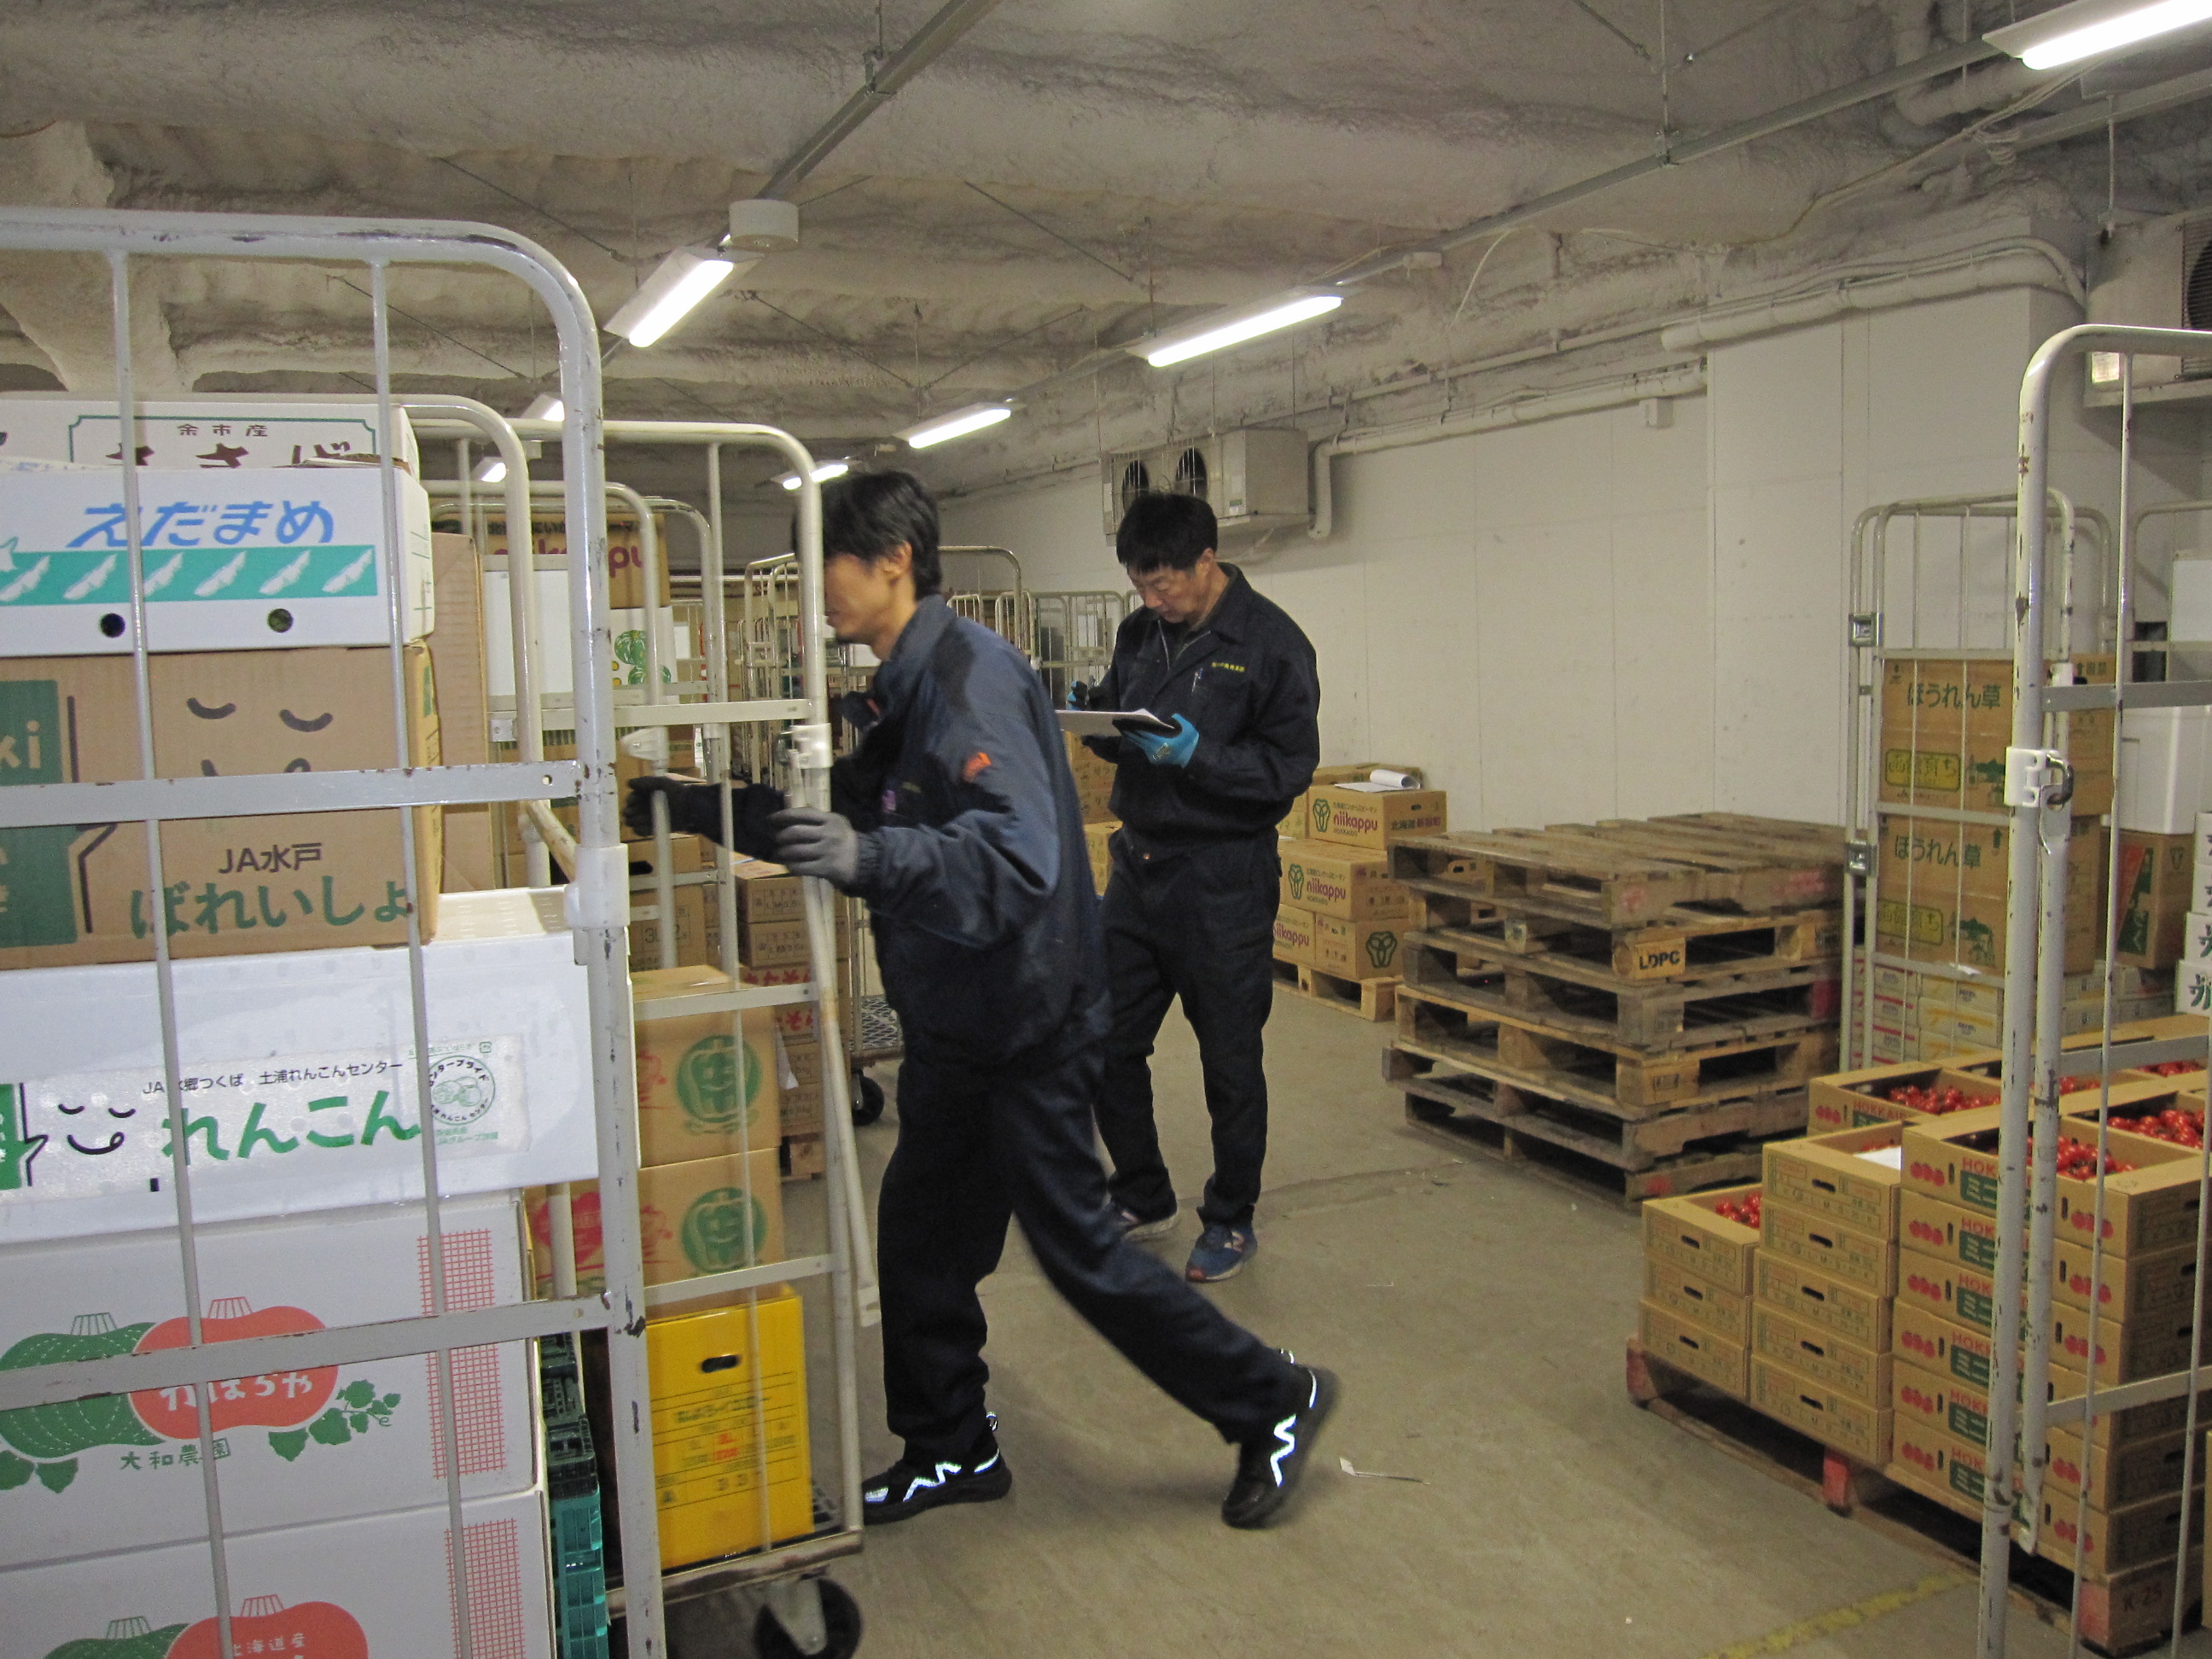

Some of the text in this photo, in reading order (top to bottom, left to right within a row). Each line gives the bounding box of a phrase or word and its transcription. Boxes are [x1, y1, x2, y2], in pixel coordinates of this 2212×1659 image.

[177, 423, 269, 437] 余市産
[66, 500, 335, 548] えだまめ
[1907, 683, 2002, 710] ほうれん草
[1333, 811, 1378, 834] niikappu
[218, 841, 322, 874] JA水戸
[1895, 835, 1982, 870] ほうれん草
[131, 874, 412, 939] ばれいしょ
[1307, 877, 1347, 903] niikappu
[143, 1062, 404, 1095] JA郷つくば 土浦れんこんセンター
[162, 1091, 422, 1165] れんこん
[120, 1437, 231, 1471] 大和農園
